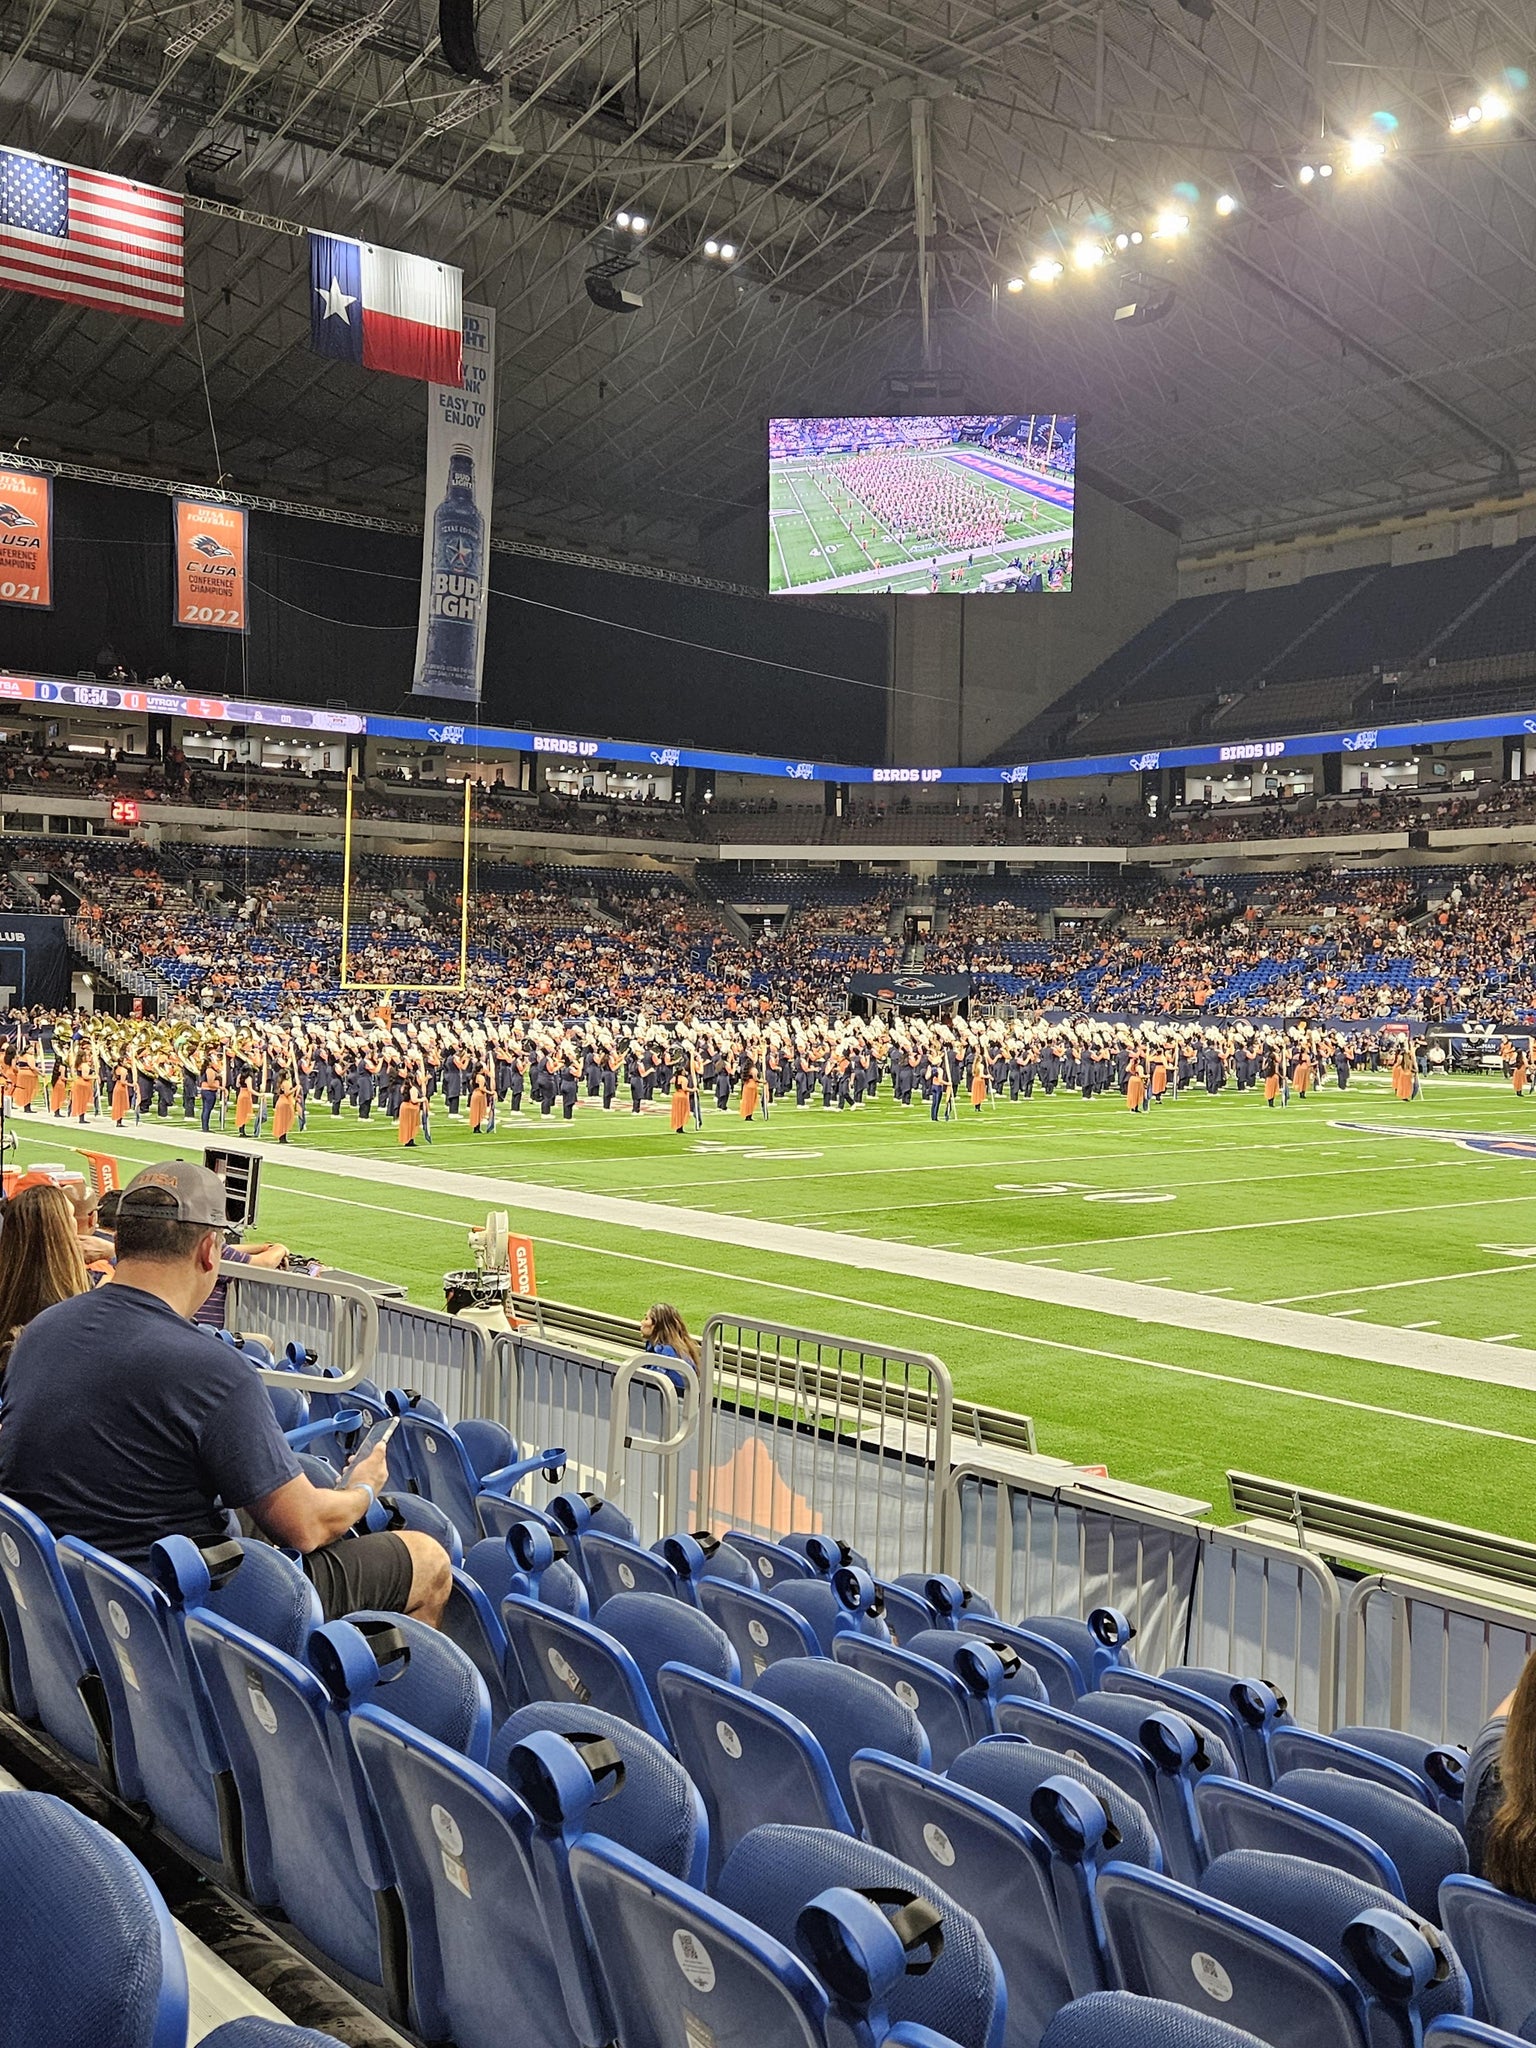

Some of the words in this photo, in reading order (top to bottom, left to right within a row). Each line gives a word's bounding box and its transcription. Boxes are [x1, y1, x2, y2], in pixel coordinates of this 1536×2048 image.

[439, 393, 469, 412] EASY
[472, 401, 486, 416] TO
[445, 409, 481, 430] ENJOY
[187, 513, 235, 528] FOOTBALL
[0, 581, 40, 601] 021
[188, 575, 234, 589] CONFERENCE
[190, 584, 233, 597] CHAMPIONS
[435, 573, 479, 599] BUD
[184, 605, 240, 625] 2022
[41, 684, 50, 699] 0
[73, 687, 108, 706] 16:54
[131, 694, 139, 708] 0
[533, 736, 577, 754] BIRDS
[579, 741, 598, 756] UP
[1220, 743, 1264, 761] BIRDS
[1265, 741, 1285, 757] UP
[872, 768, 920, 782] BIRDS
[921, 768, 942, 782] UP
[112, 801, 136, 820] 25
[0, 931, 26, 942] LUB
[101, 1164, 114, 1193] GATO
[138, 1173, 179, 1189] UTSA
[516, 1246, 530, 1295] GATOR
